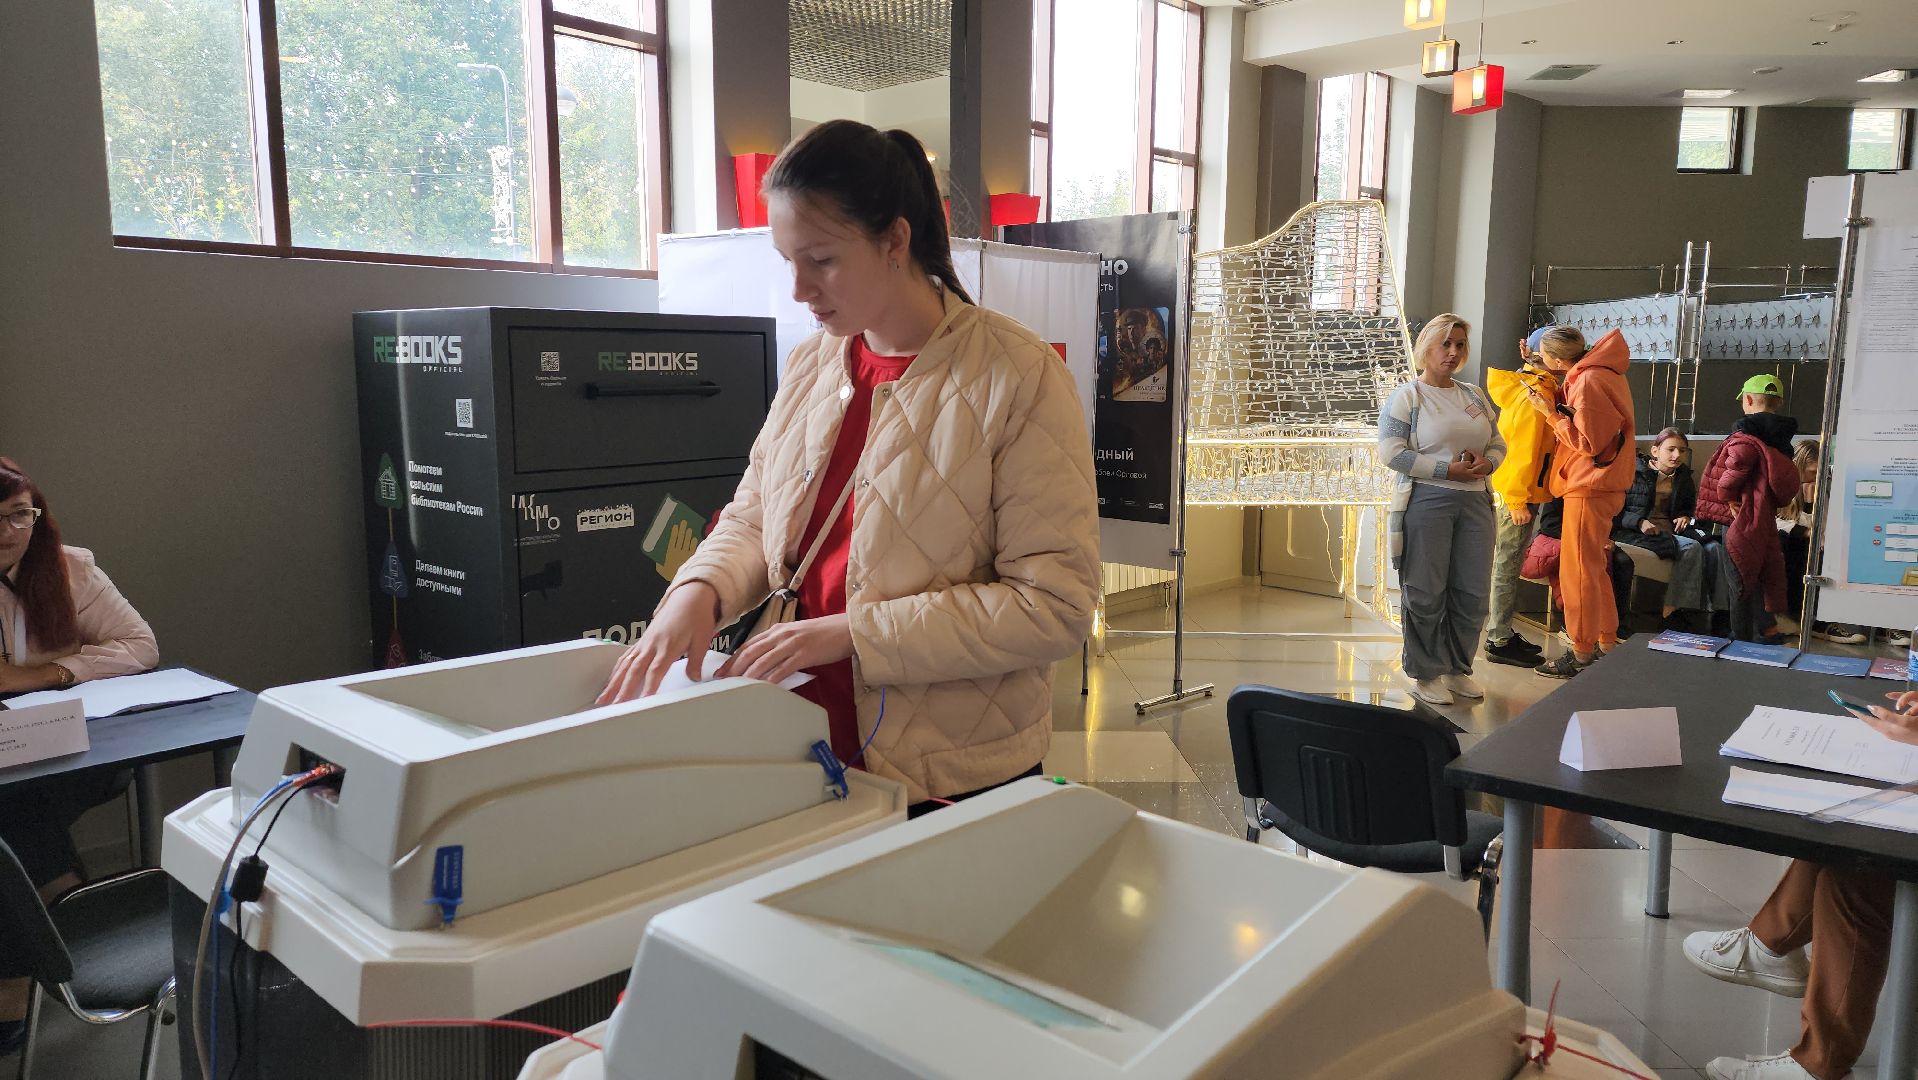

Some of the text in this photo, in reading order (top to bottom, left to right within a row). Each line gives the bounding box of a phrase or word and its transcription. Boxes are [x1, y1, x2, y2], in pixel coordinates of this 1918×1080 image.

[373, 335, 463, 365] RE:BOOKS
[598, 351, 699, 371] RE:BOOKS
[408, 460, 443, 476] Помогаем
[409, 480, 443, 493] сельским
[410, 493, 484, 517] библиотекам России
[579, 511, 632, 526] РЕГИОН
[415, 559, 465, 581] Делаем книги
[416, 577, 462, 597] доступными
